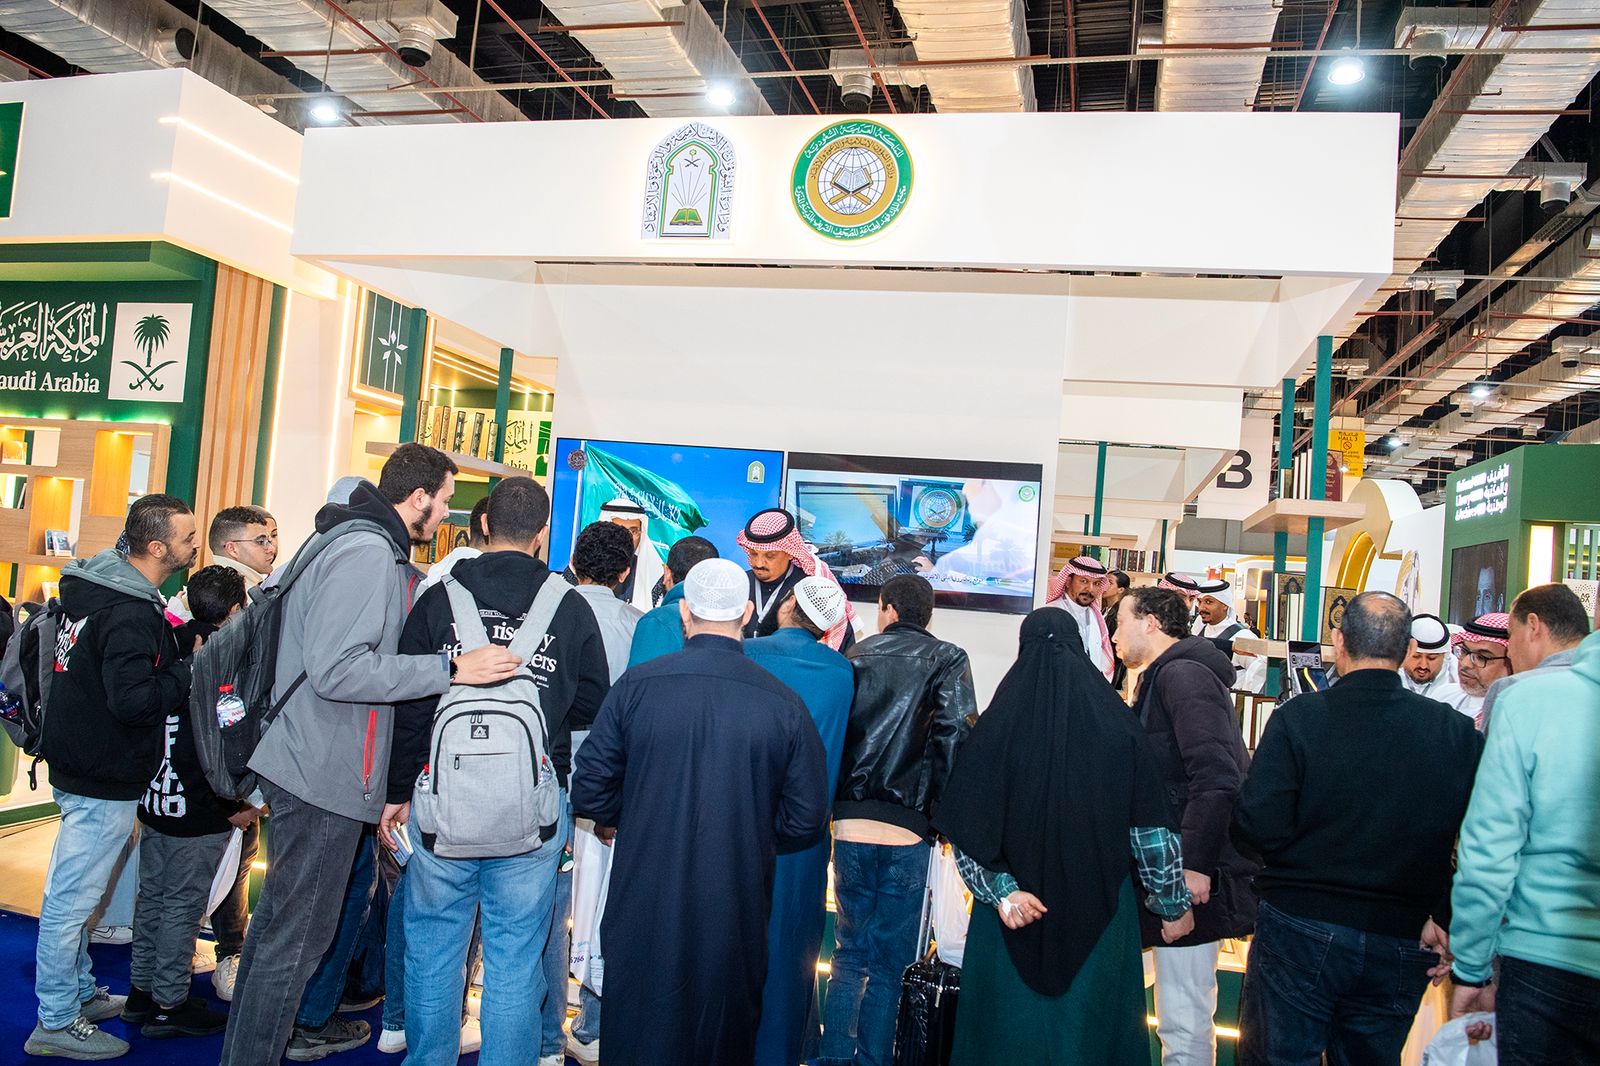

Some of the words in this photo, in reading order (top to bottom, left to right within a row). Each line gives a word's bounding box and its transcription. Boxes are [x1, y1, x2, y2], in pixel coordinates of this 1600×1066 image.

[0, 370, 37, 391] audi
[38, 371, 100, 393] Arabia
[1216, 449, 1253, 490] B
